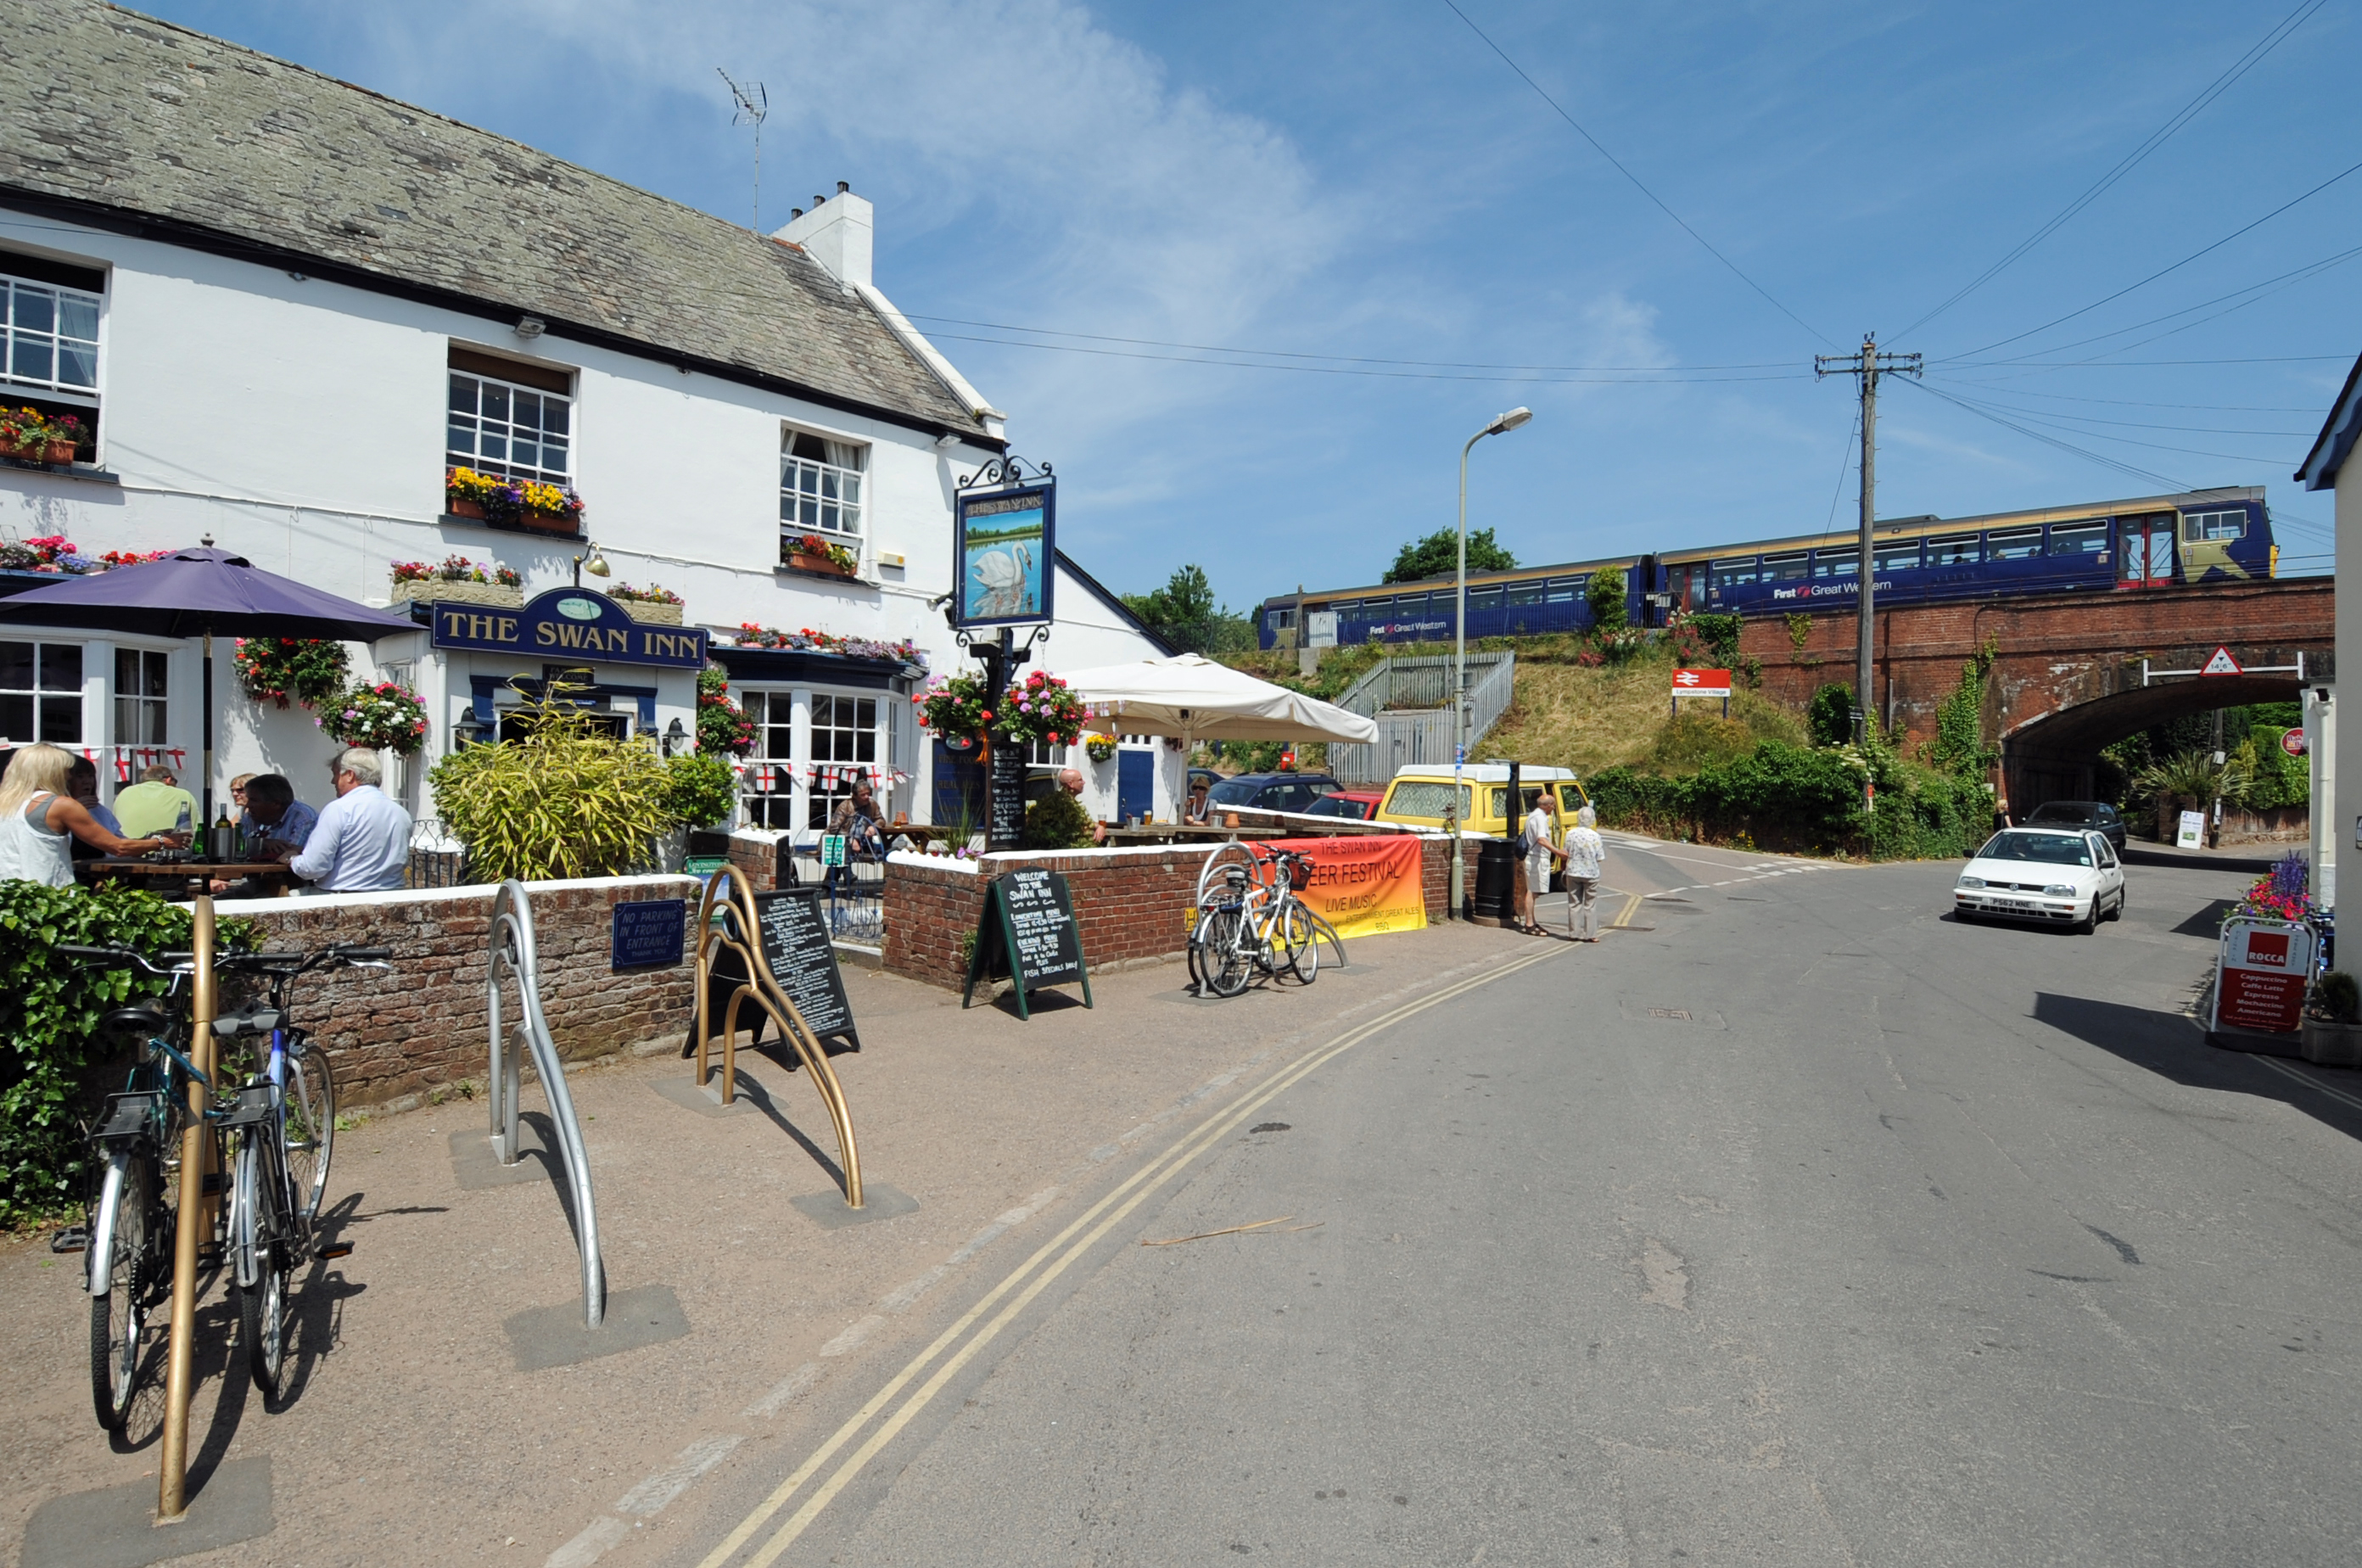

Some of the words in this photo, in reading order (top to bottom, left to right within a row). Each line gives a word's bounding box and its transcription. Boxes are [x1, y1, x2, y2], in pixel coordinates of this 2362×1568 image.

[1774, 588, 1796, 599] First
[1811, 585, 1842, 596] Great
[1843, 580, 1891, 593] Weern
[1394, 623, 1414, 634] Great
[443, 612, 519, 642] THE
[536, 621, 629, 653] SWAN
[644, 632, 700, 659] INN
[1320, 842, 1338, 854] THE
[1341, 841, 1365, 854] SWAN
[1369, 841, 1382, 852] INN
[1014, 871, 1049, 882] WELCOME
[1342, 860, 1400, 884] FESTIVAL
[1018, 882, 1029, 891] TO
[1029, 881, 1043, 889] THE
[1009, 889, 1035, 901] SWAN
[1038, 888, 1052, 898] INN
[1325, 896, 1346, 912] LIVE
[1349, 893, 1377, 910] MUSIC
[623, 913, 635, 923] NO
[640, 910, 678, 922] PARKING
[1405, 906, 1419, 916] ALES
[619, 926, 630, 937] IN
[635, 924, 663, 936] FRONT
[668, 921, 679, 932] OF
[627, 935, 671, 949] ENTRANCE
[2248, 952, 2285, 963] ROCCA
[2240, 973, 2287, 984] Cappuccino
[2244, 991, 2280, 1000] Espresso
[2237, 1007, 2281, 1017] Americano
